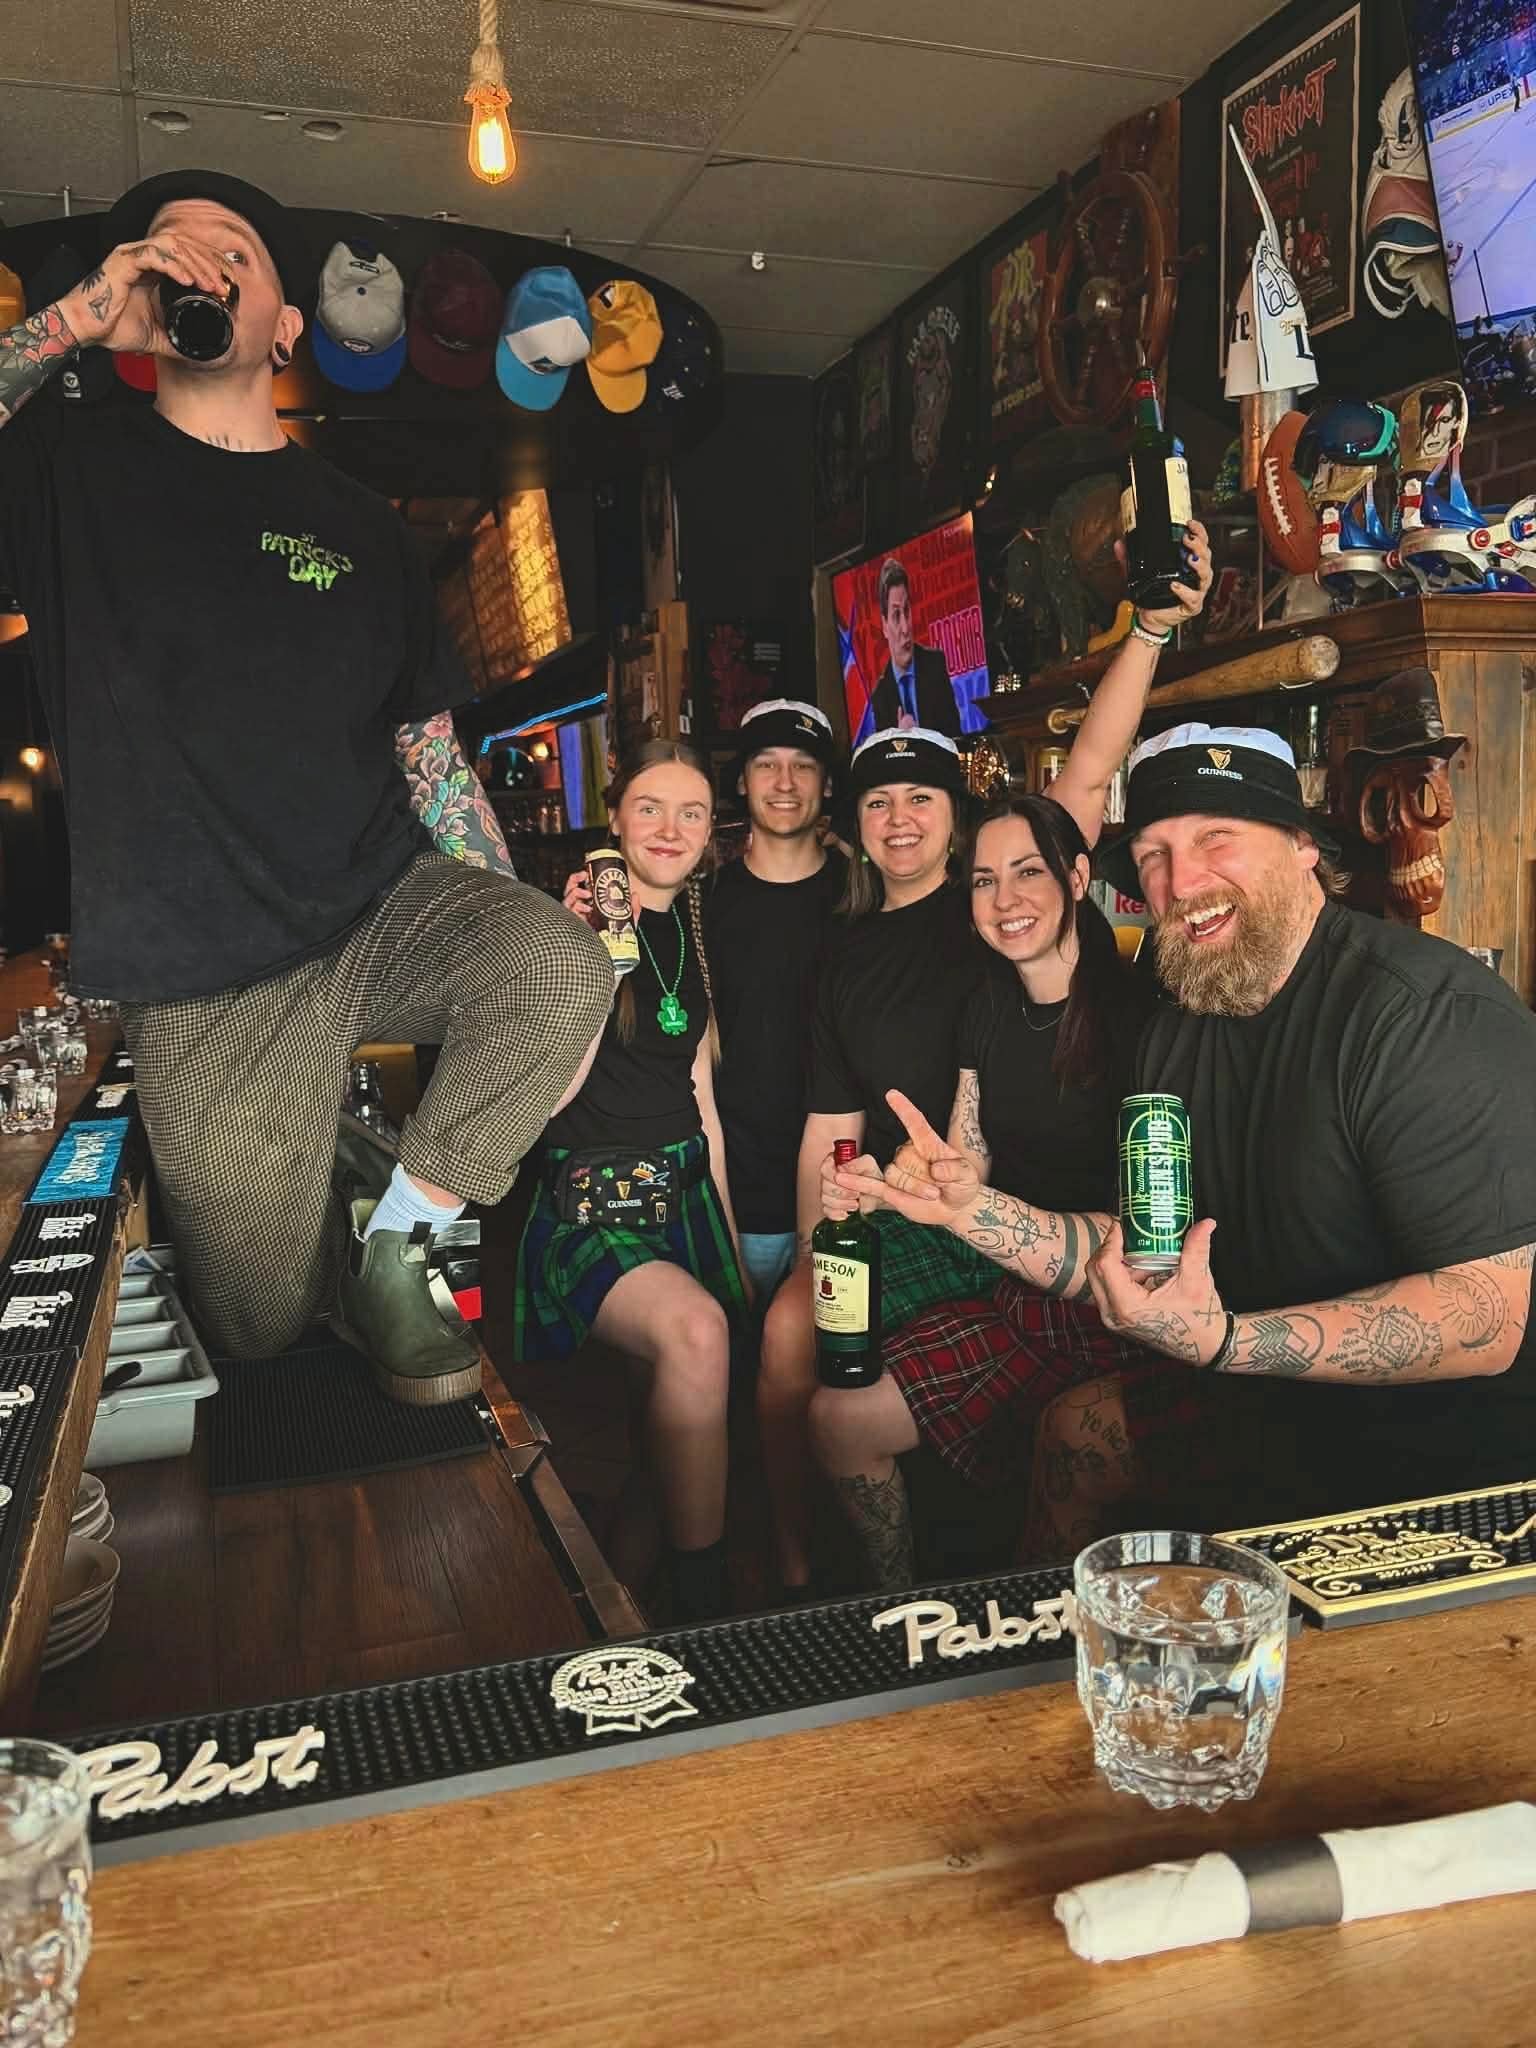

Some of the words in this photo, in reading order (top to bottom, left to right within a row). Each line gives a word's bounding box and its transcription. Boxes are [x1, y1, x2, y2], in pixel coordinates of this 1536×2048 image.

[261, 531, 354, 573] PATRICK'S
[288, 555, 339, 592] DAY
[1197, 767, 1243, 781] GUINNESS
[1147, 1118, 1173, 1153] PUB
[607, 1198, 643, 1209] GUINNESS
[1148, 1156, 1176, 1229] DUBLIN'S
[872, 1589, 1080, 1669] Pabst
[550, 1686, 609, 1709] Blue
[606, 1670, 696, 1697] Ribbon
[577, 1658, 650, 1688] Pabst
[80, 1725, 326, 1820] Pabst
